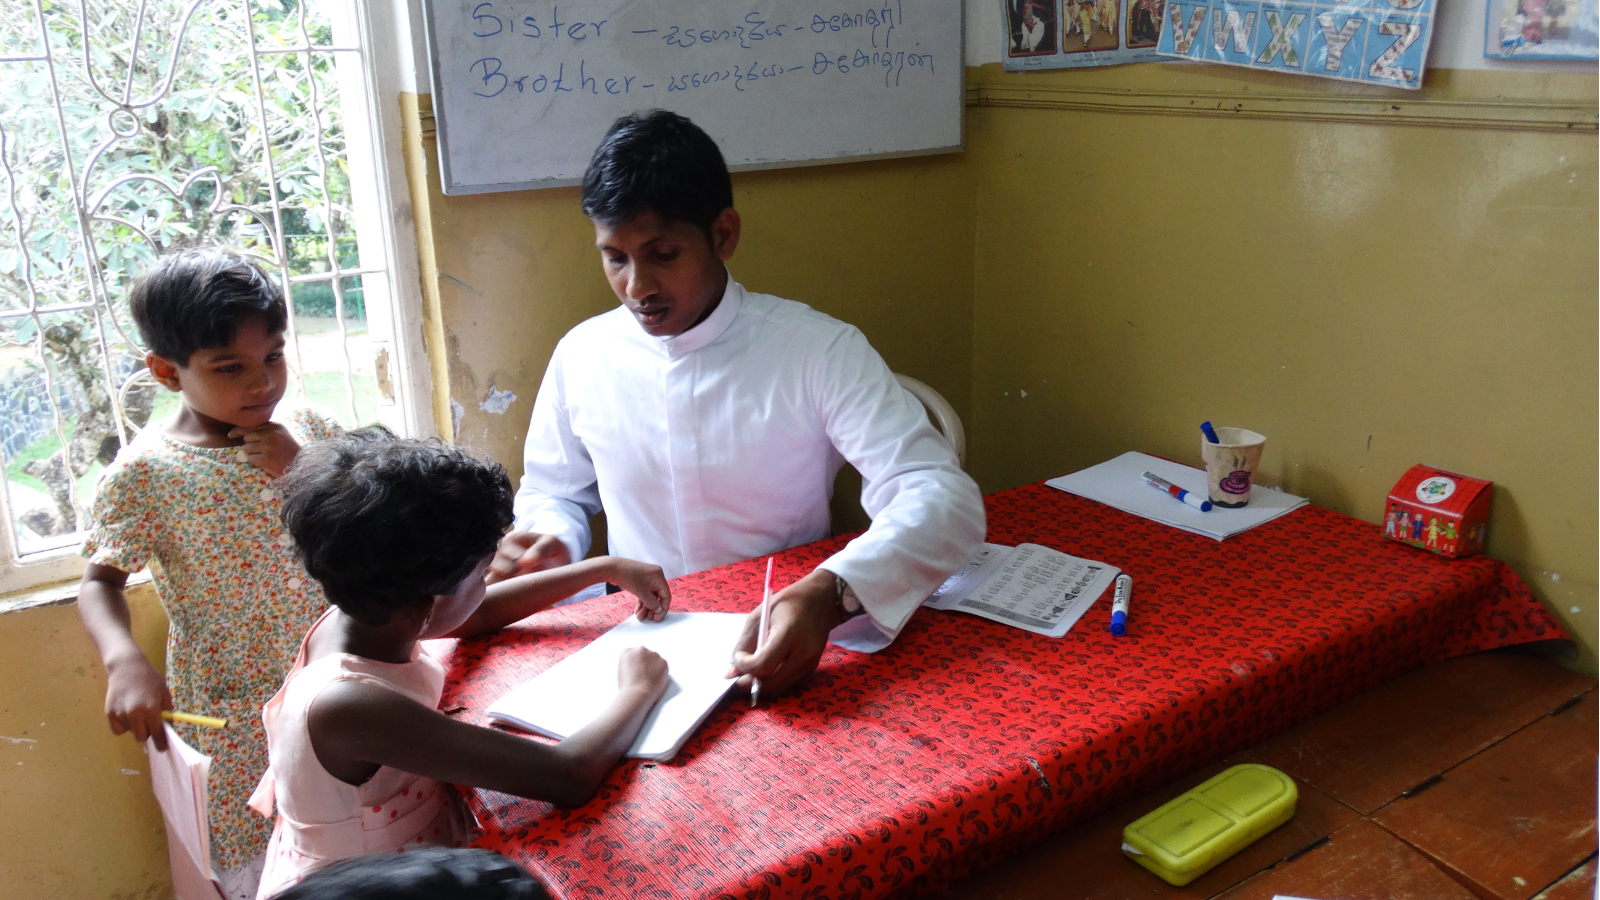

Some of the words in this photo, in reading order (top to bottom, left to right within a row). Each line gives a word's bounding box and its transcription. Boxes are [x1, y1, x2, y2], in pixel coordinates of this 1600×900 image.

[472, 2, 607, 40] Sister
[1168, 2, 1209, 54] V
[1213, 8, 1257, 54] W
[1255, 10, 1307, 68] X
[1316, 13, 1366, 72] Y
[1368, 21, 1422, 82] Z
[469, 57, 636, 97] Brother
